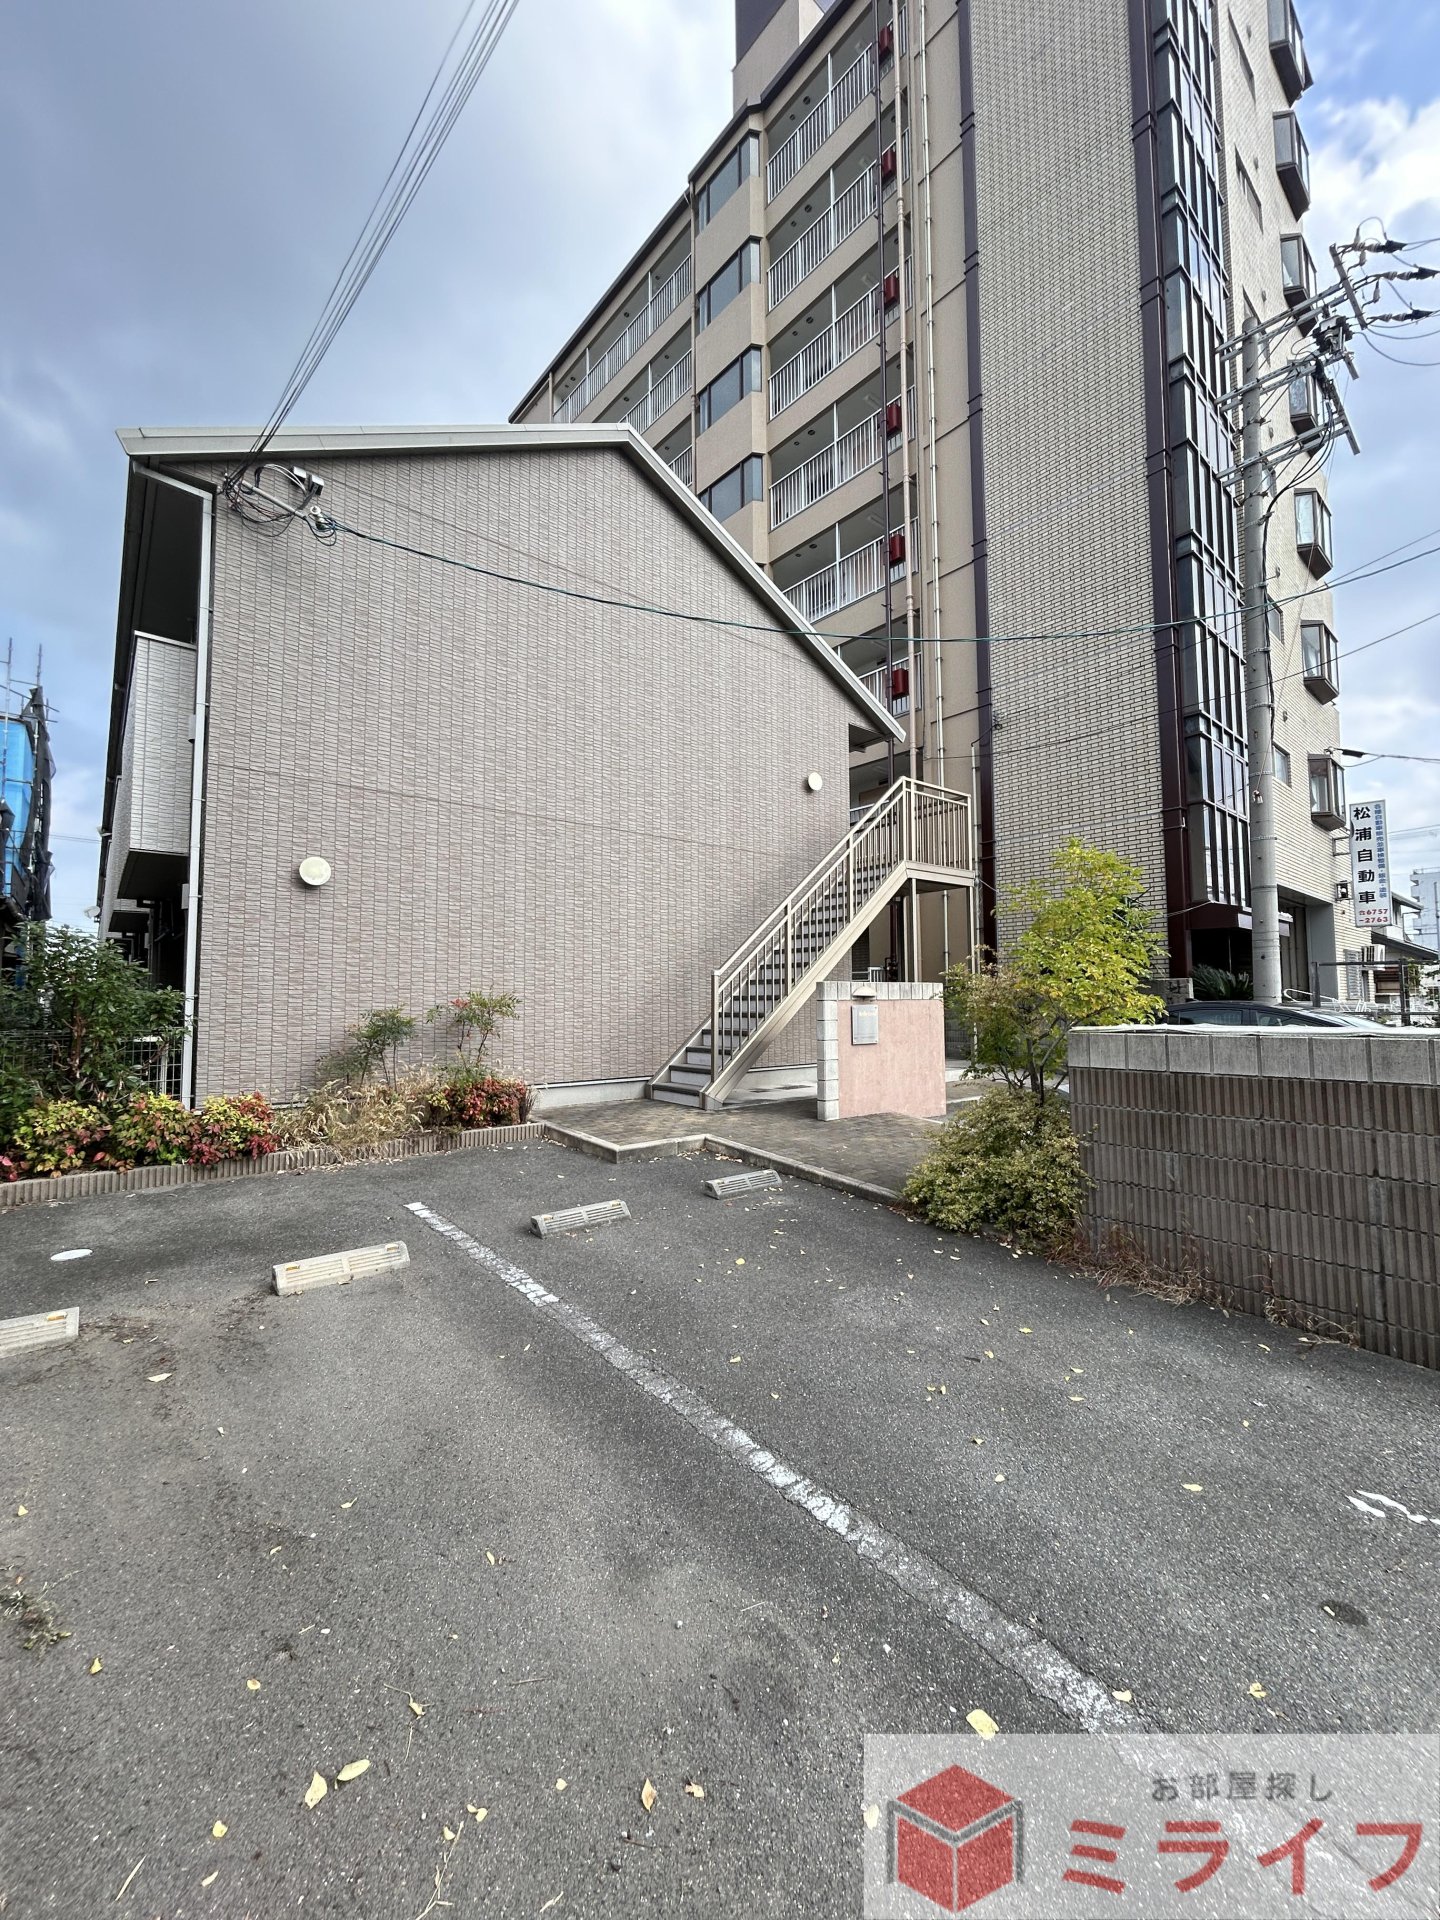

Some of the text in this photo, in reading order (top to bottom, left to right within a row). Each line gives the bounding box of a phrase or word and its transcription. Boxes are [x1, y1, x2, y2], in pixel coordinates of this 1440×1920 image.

[1353, 806, 1376, 904] 松浦自動車
